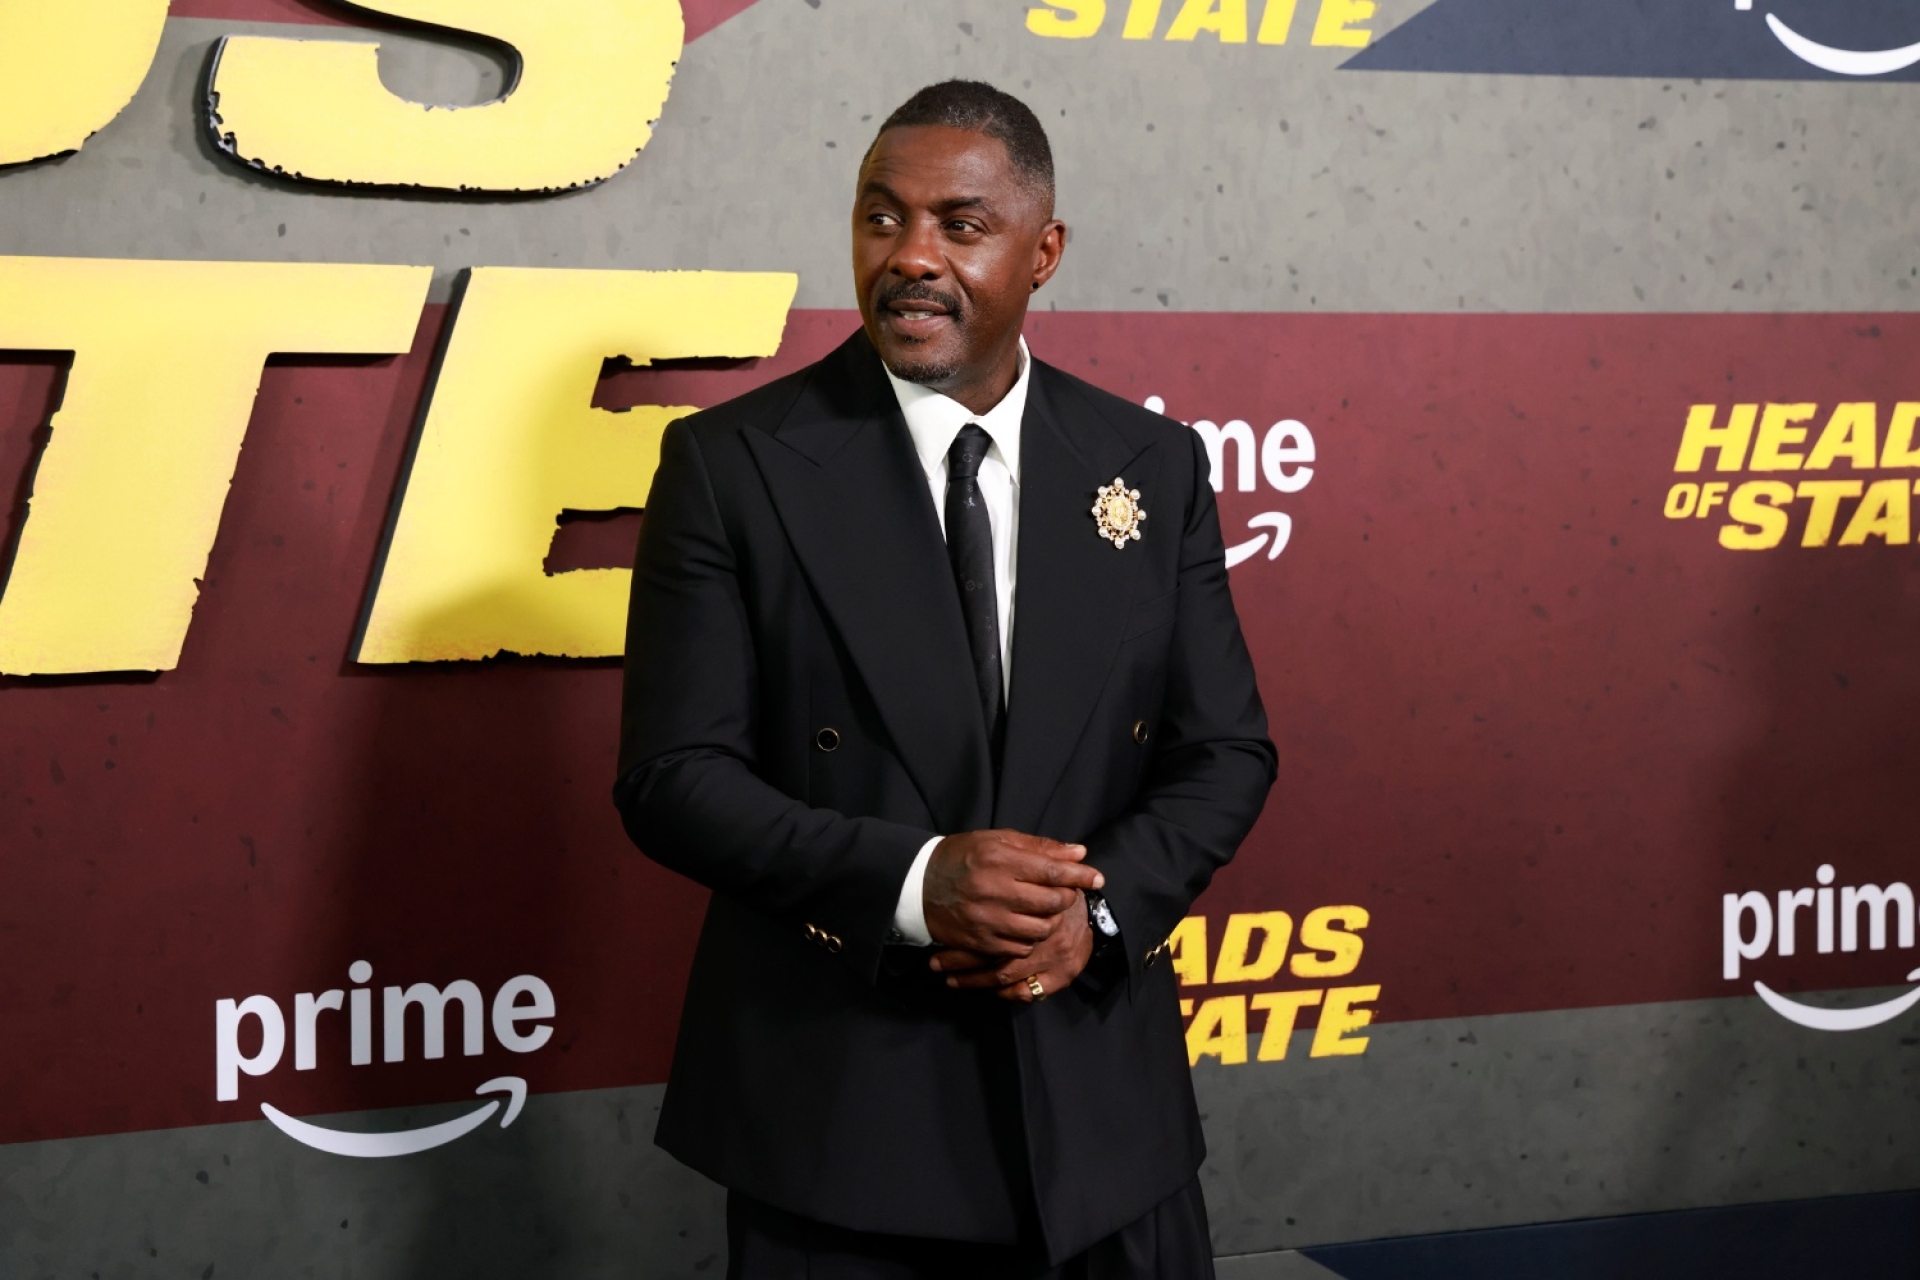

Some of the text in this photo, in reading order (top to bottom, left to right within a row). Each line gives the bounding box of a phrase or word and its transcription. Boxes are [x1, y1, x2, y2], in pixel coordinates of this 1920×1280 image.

[1144, 395, 1316, 493] me
[1664, 479, 1920, 550] OF STA
[1723, 864, 1920, 980] prim
[216, 960, 556, 1102] prime
[1179, 984, 1381, 1067] ATE
